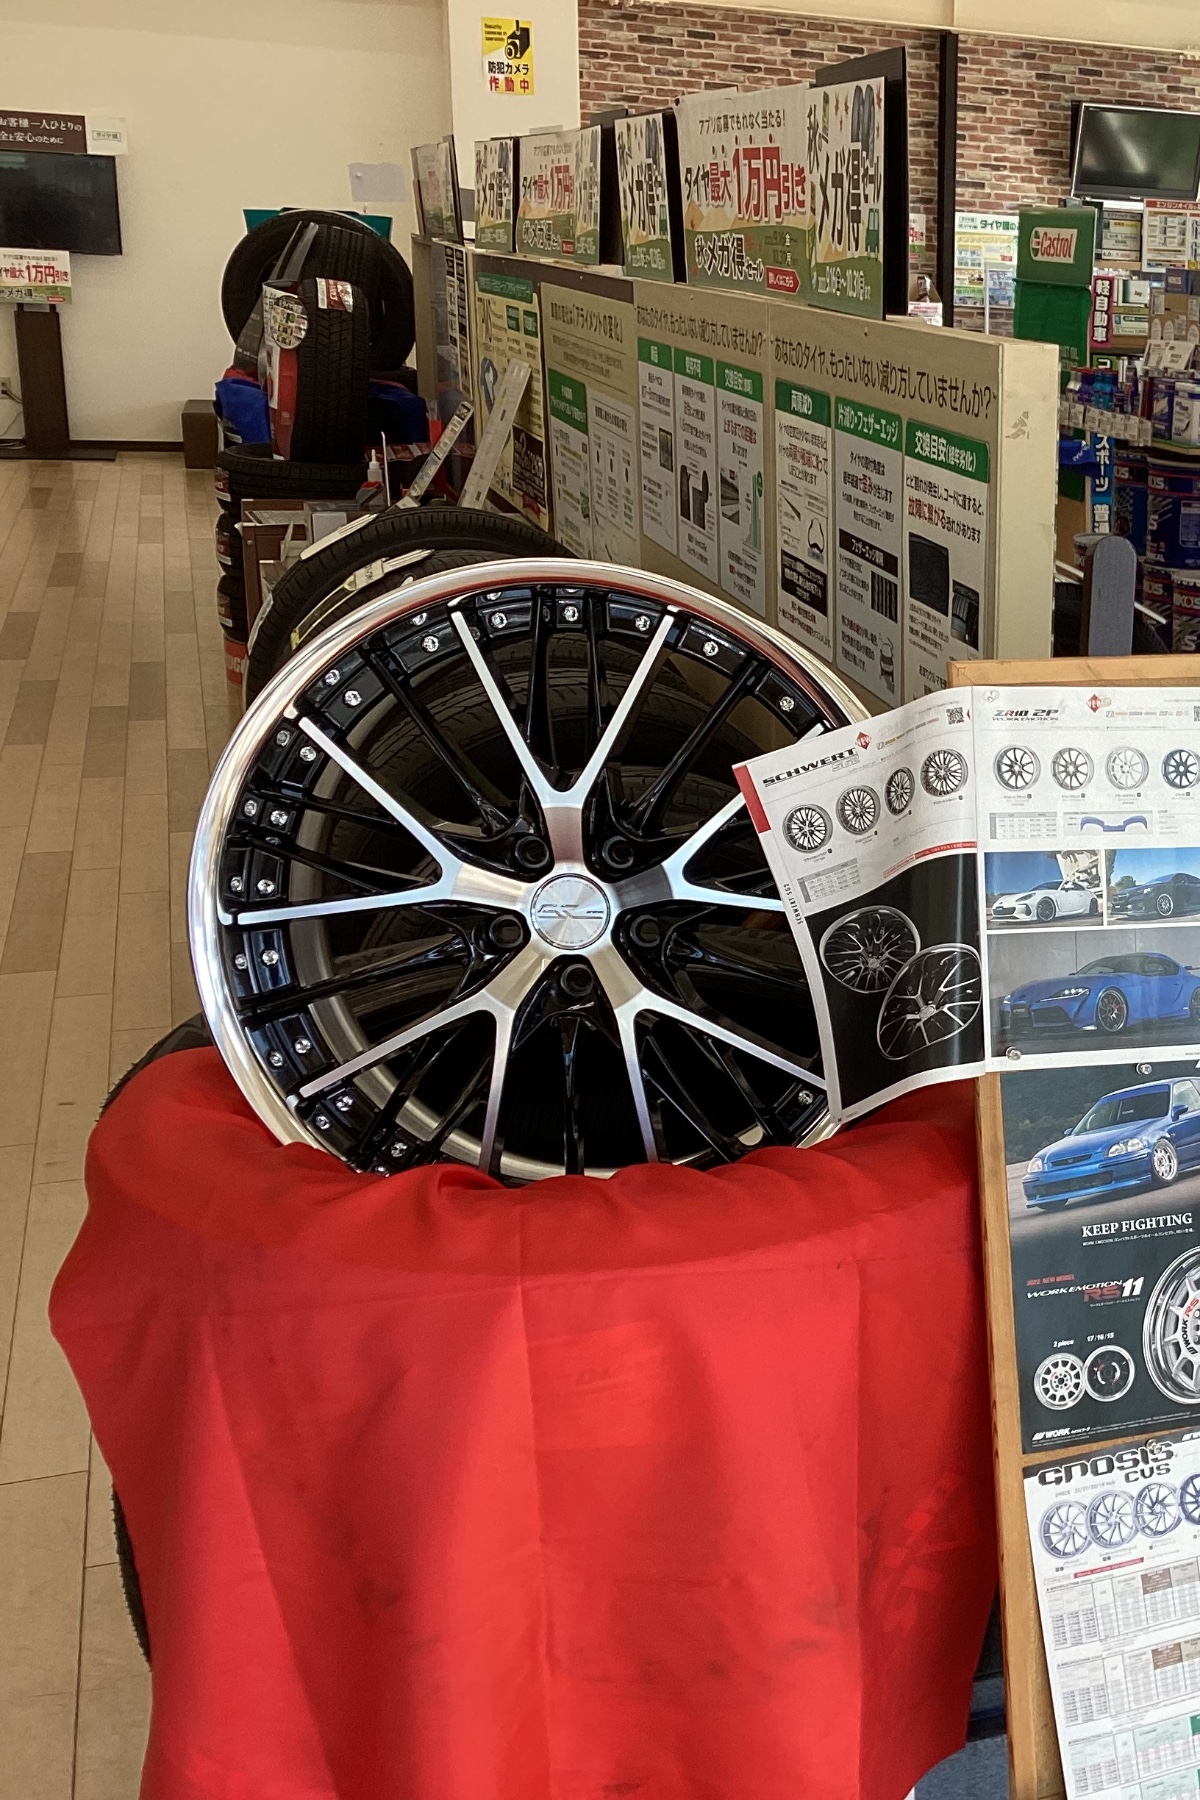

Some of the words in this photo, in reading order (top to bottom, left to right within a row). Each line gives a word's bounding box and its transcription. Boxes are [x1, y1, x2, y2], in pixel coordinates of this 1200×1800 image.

[488, 60, 529, 75] 防犯カメラ
[489, 76, 529, 93] 作動中
[699, 109, 785, 135] アプリ応募でもれなく当たる！
[685, 145, 806, 219] タイヤ最大1万円引き
[818, 146, 881, 252] メガ得セール
[1040, 231, 1074, 258] Castrol
[1092, 279, 1110, 342] 軽自動車
[774, 335, 991, 419] あなたのタイヤ、もったいない減り方していませんか？
[994, 709, 1029, 717] ZR10
[1032, 708, 1059, 717] 2P
[762, 747, 857, 786] SCHWERT
[1082, 1222, 1119, 1238] KEEP
[1121, 1212, 1193, 1232] FIGHTING
[1027, 1285, 1068, 1299] WORK
[1068, 1279, 1123, 1293] EMOTION
[1083, 1287, 1122, 1302] RS
[1122, 1276, 1144, 1298] 11
[1045, 1427, 1071, 1438] WORK
